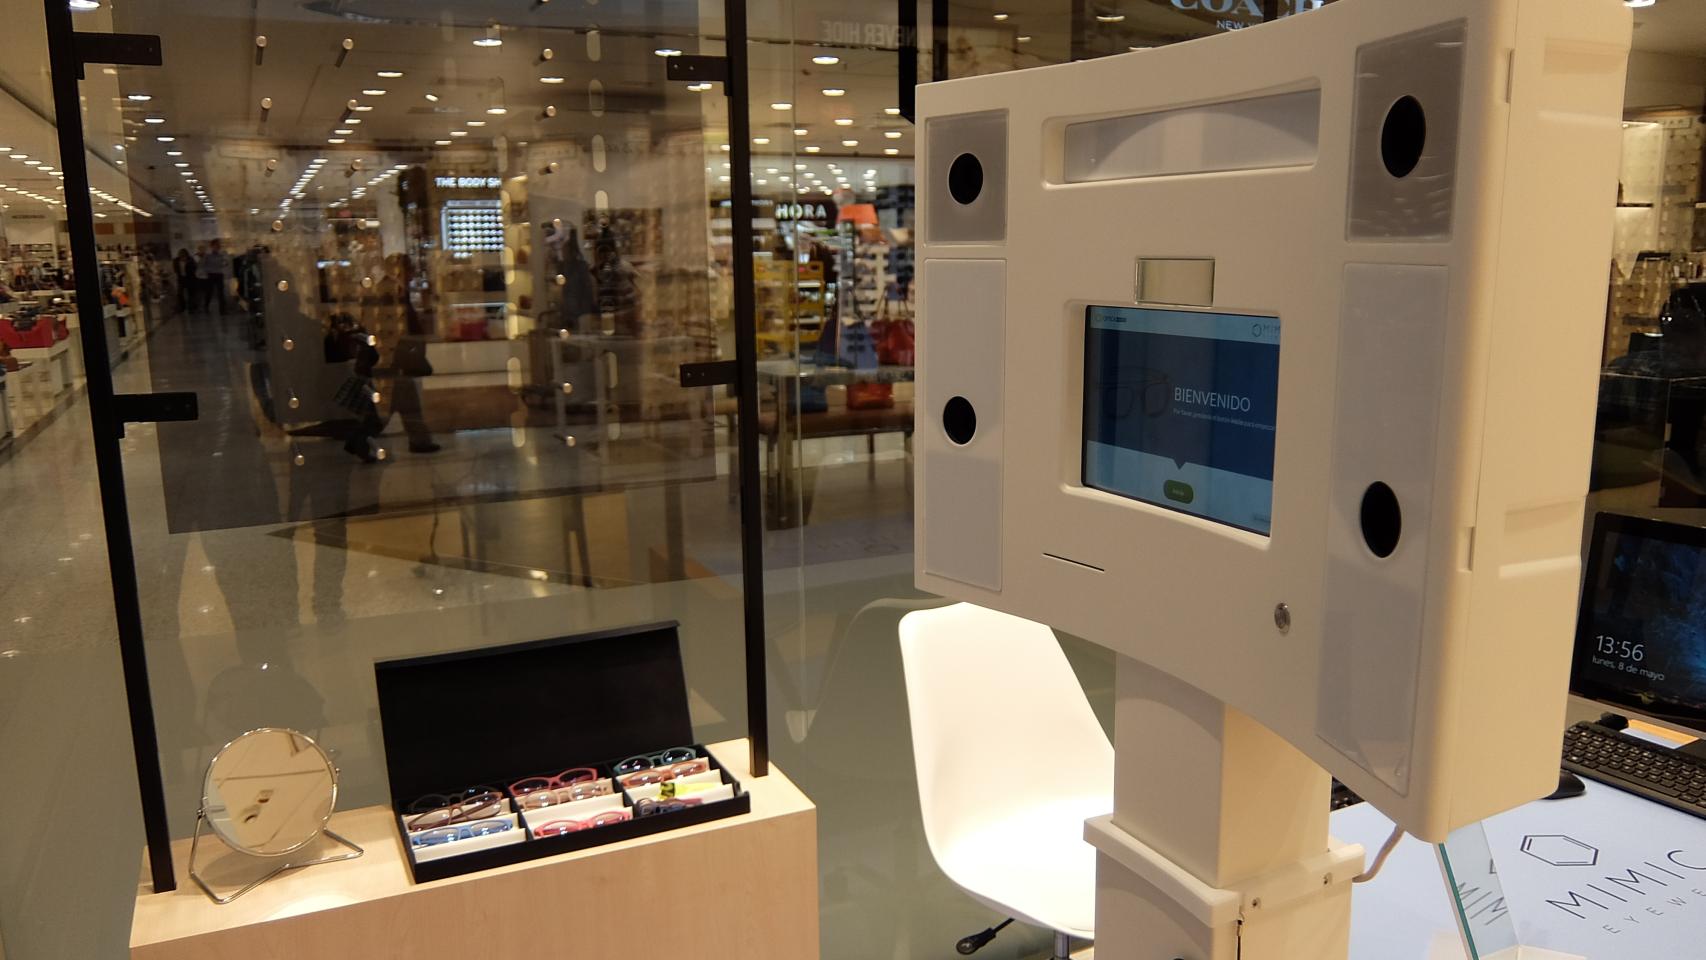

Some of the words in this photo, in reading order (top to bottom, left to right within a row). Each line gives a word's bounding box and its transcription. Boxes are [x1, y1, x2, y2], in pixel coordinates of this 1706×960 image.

[1216, 20, 1244, 29] NEW
[434, 177, 457, 188] THE
[458, 177, 486, 188] BODY
[775, 203, 827, 219] HORA
[1174, 387, 1251, 411] BIENVENIDO
[1596, 635, 1644, 661] 13:56
[1592, 656, 1615, 669] lunes,
[1618, 661, 1624, 671] 8
[1626, 665, 1638, 674] de
[1640, 669, 1665, 681] mayo
[1545, 849, 1706, 919] MIMIC
